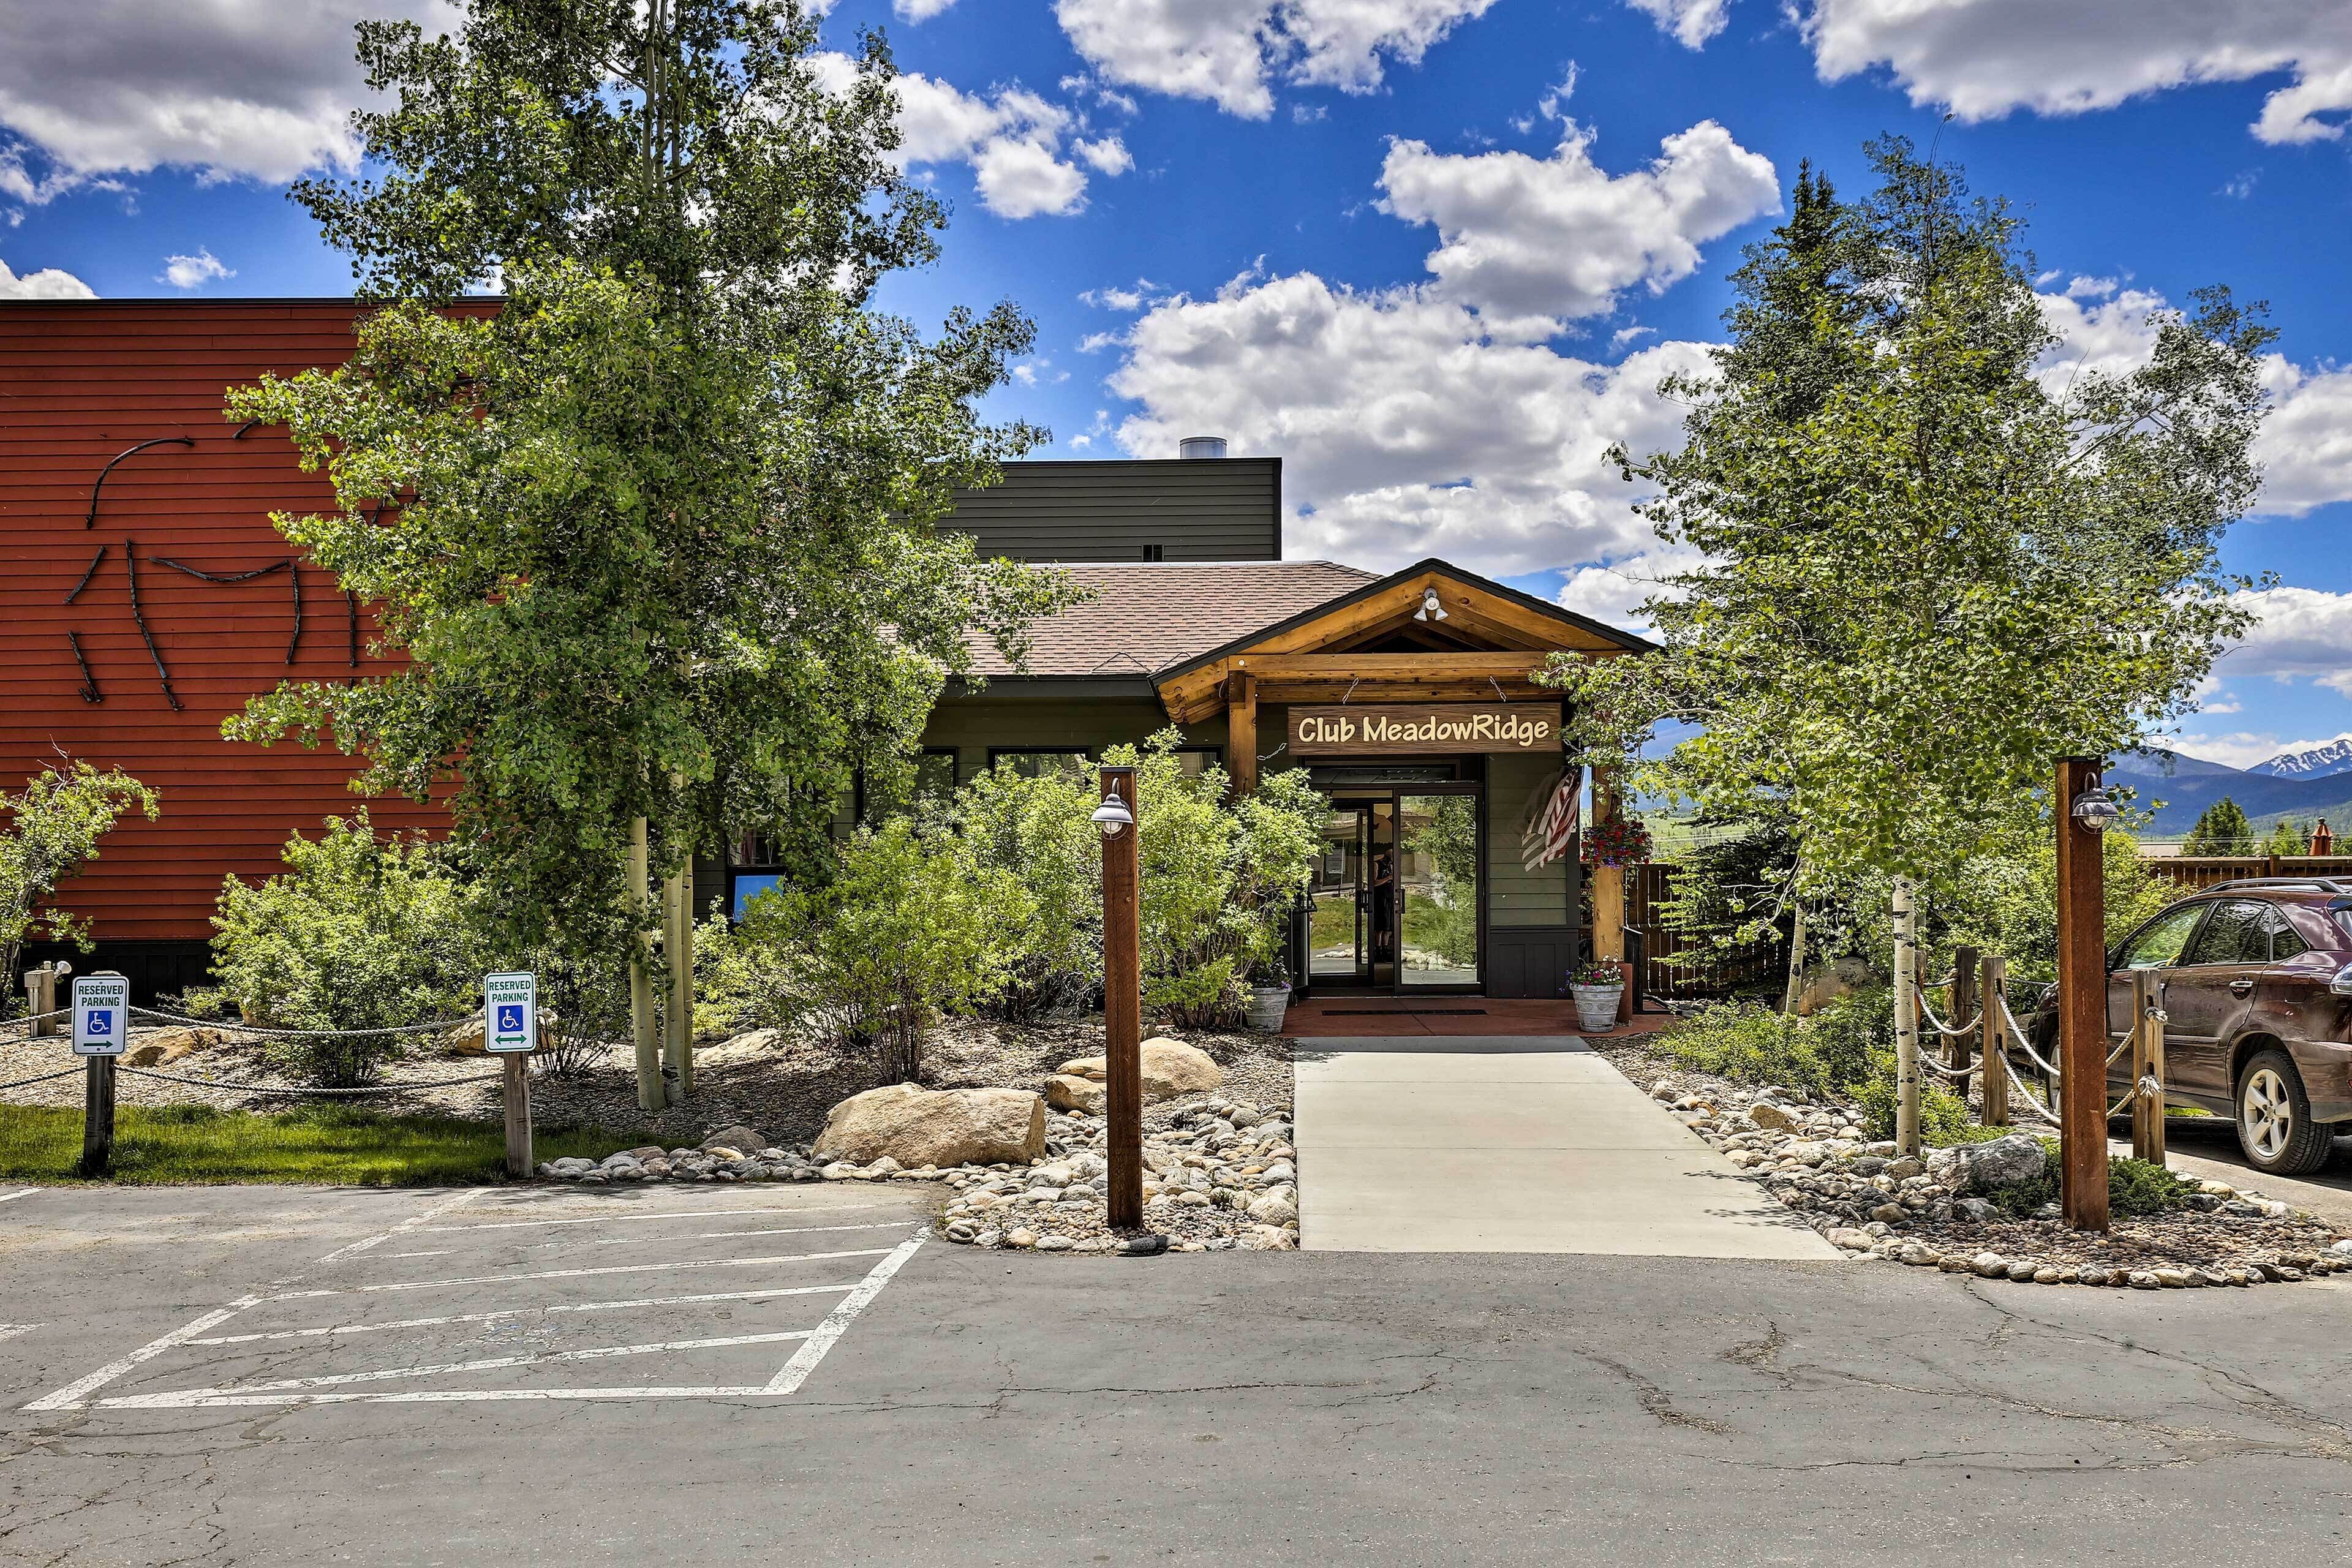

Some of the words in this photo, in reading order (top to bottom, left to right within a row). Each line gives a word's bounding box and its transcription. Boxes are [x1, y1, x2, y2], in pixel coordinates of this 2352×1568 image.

[1298, 716, 1355, 743] Club
[1362, 714, 1550, 747] MeadowRidge
[78, 985, 123, 995] RESERVED
[488, 980, 531, 991] RESERVED
[81, 997, 120, 1006] PARKING
[492, 992, 529, 1003] PARKING
